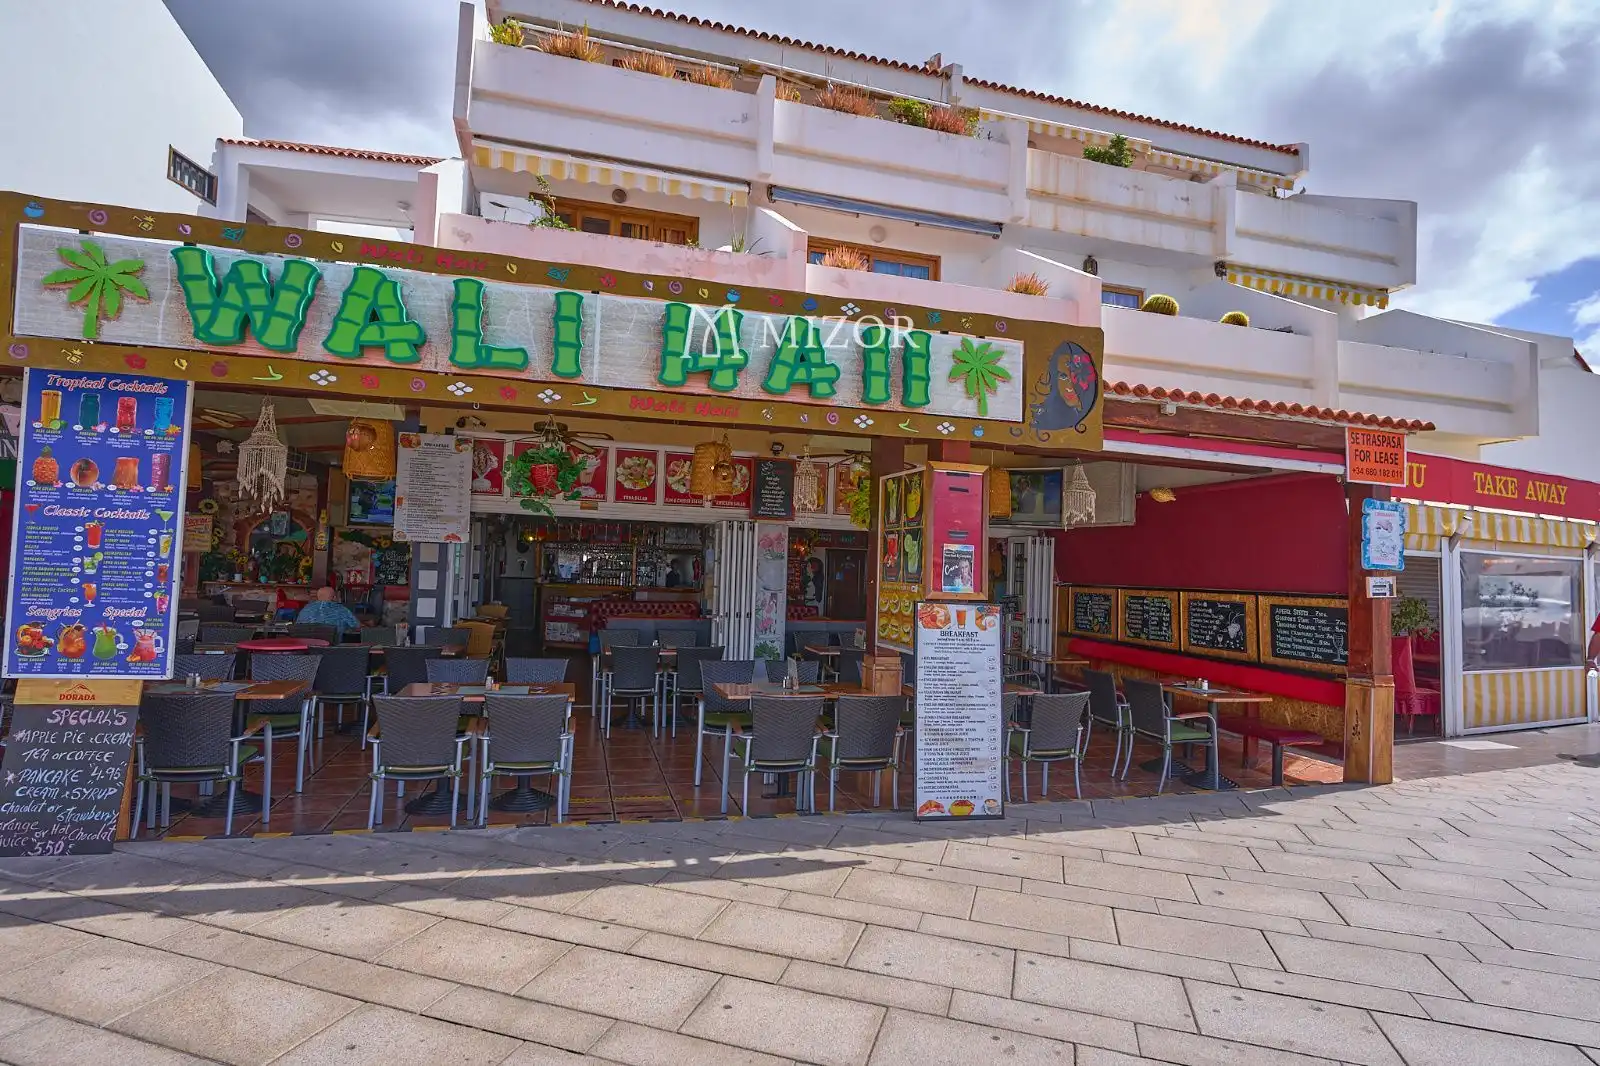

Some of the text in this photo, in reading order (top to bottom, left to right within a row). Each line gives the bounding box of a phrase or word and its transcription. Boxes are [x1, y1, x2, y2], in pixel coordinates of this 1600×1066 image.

[170, 245, 585, 380] WALI
[47, 374, 168, 394] Tropical Cocktails
[1351, 432, 1402, 449] SE TRASPASA
[1355, 449, 1398, 465] FOR LEASE
[1473, 472, 1518, 498] TAKE
[1525, 480, 1568, 505] AWAY
[44, 504, 150, 520] Classic Cocktails
[26, 606, 147, 620] Sangrias Special
[22, 748, 114, 762] TEA or COFFEE
[18, 768, 83, 786] PANCAKE
[15, 786, 62, 799] CREAM
[71, 787, 118, 800] SYRUP
[47, 804, 62, 812] or
[35, 829, 49, 838] or
[52, 823, 70, 835] Hot
